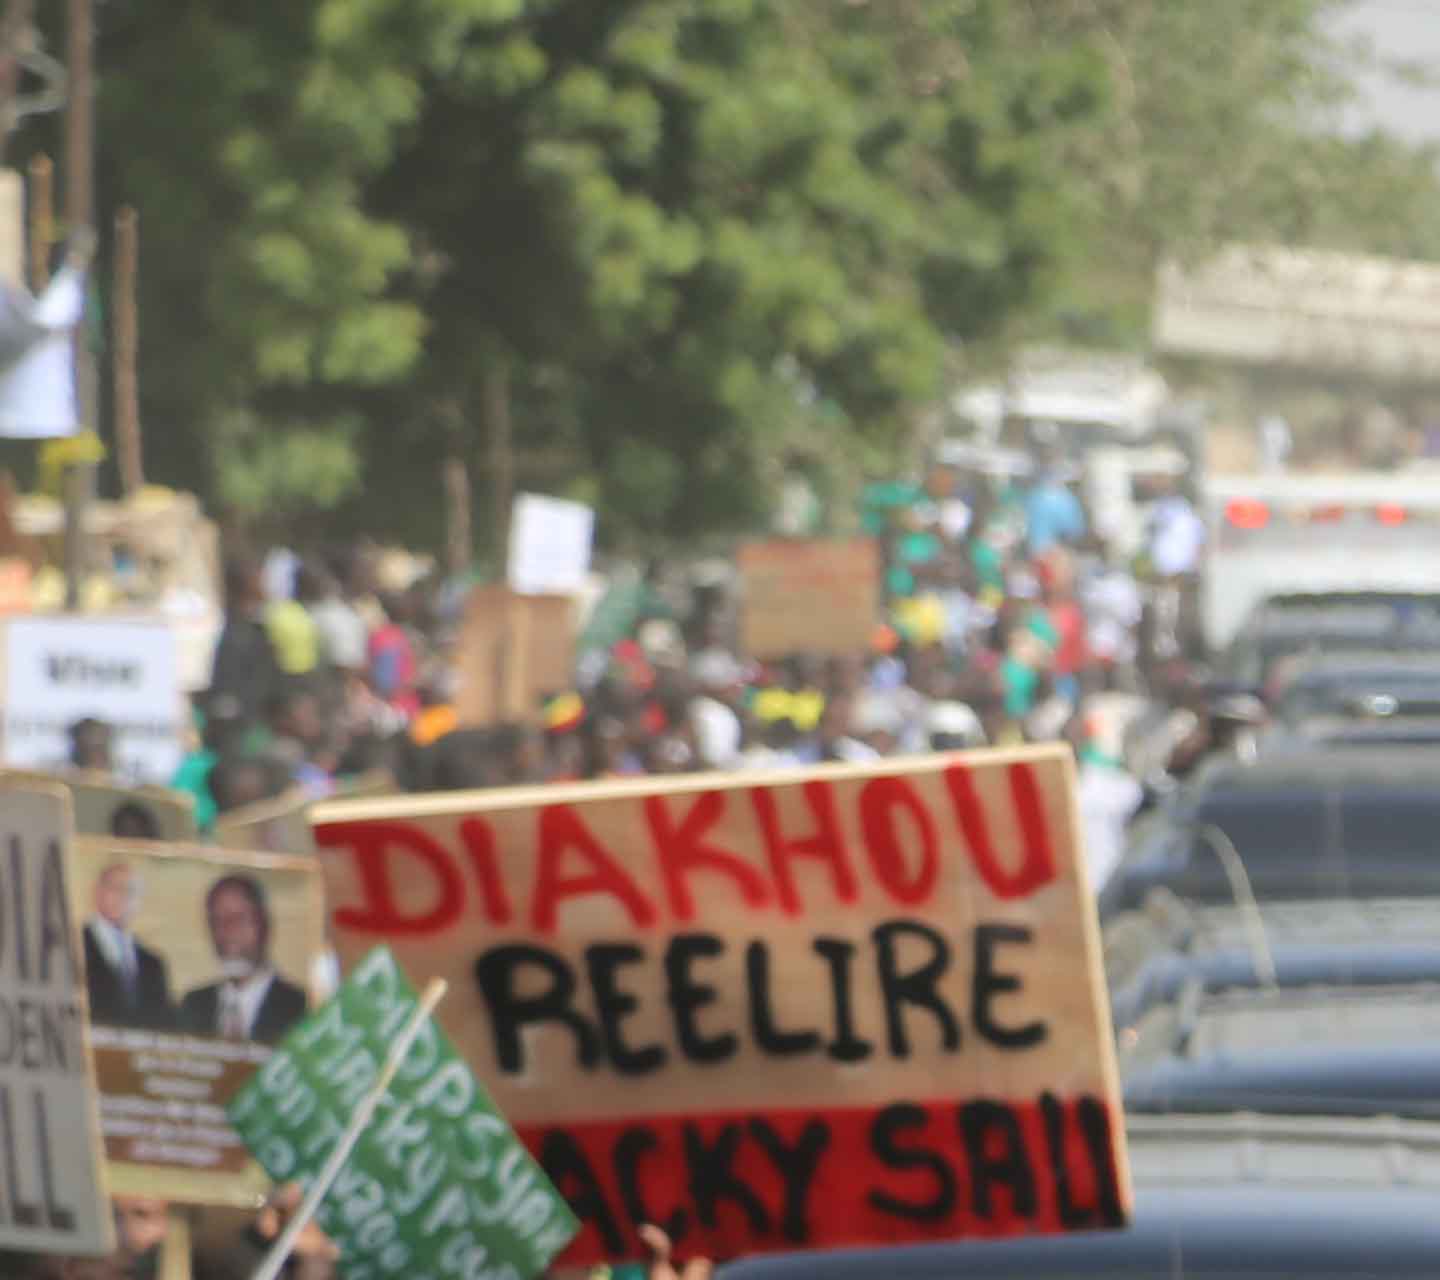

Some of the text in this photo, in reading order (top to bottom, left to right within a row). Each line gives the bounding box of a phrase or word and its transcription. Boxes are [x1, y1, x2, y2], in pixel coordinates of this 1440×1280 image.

[312, 760, 1058, 940] DIAKHOU
[474, 916, 1049, 1076] REELIRE
[541, 1114, 833, 1263] ACKY
